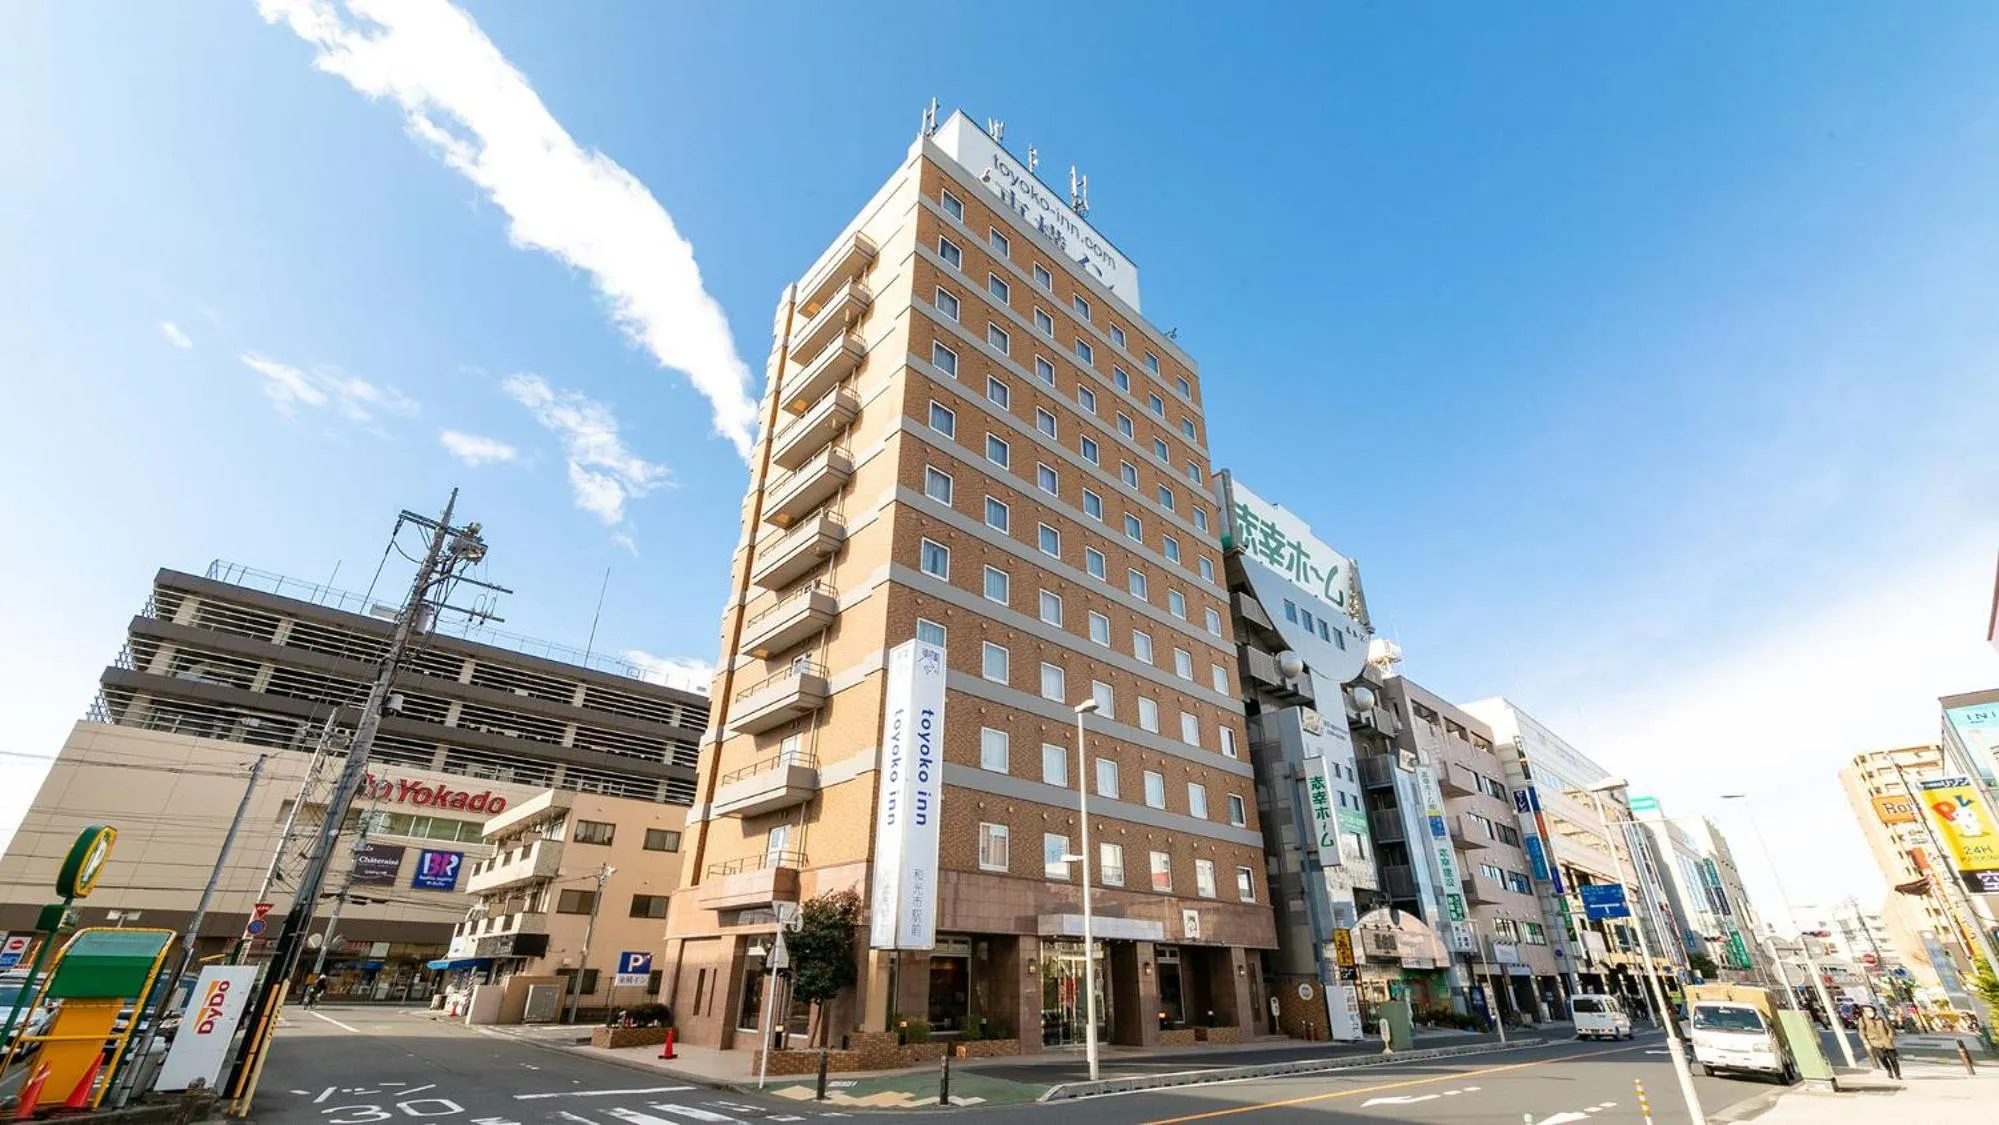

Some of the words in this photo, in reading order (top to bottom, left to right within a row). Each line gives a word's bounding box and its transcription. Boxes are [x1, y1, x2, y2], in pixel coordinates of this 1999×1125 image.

[992, 153, 1117, 270] toyoko-inn.com
[889, 707, 904, 783] toyoko
[917, 708, 935, 783] toyoko
[398, 779, 506, 814] Yokado
[886, 789, 897, 827] inn
[915, 790, 932, 827] inn
[1309, 775, 1334, 848] 志幸ホーム
[628, 954, 644, 972] P
[196, 980, 231, 1035] DyDo
[320, 1098, 466, 1124] 30
